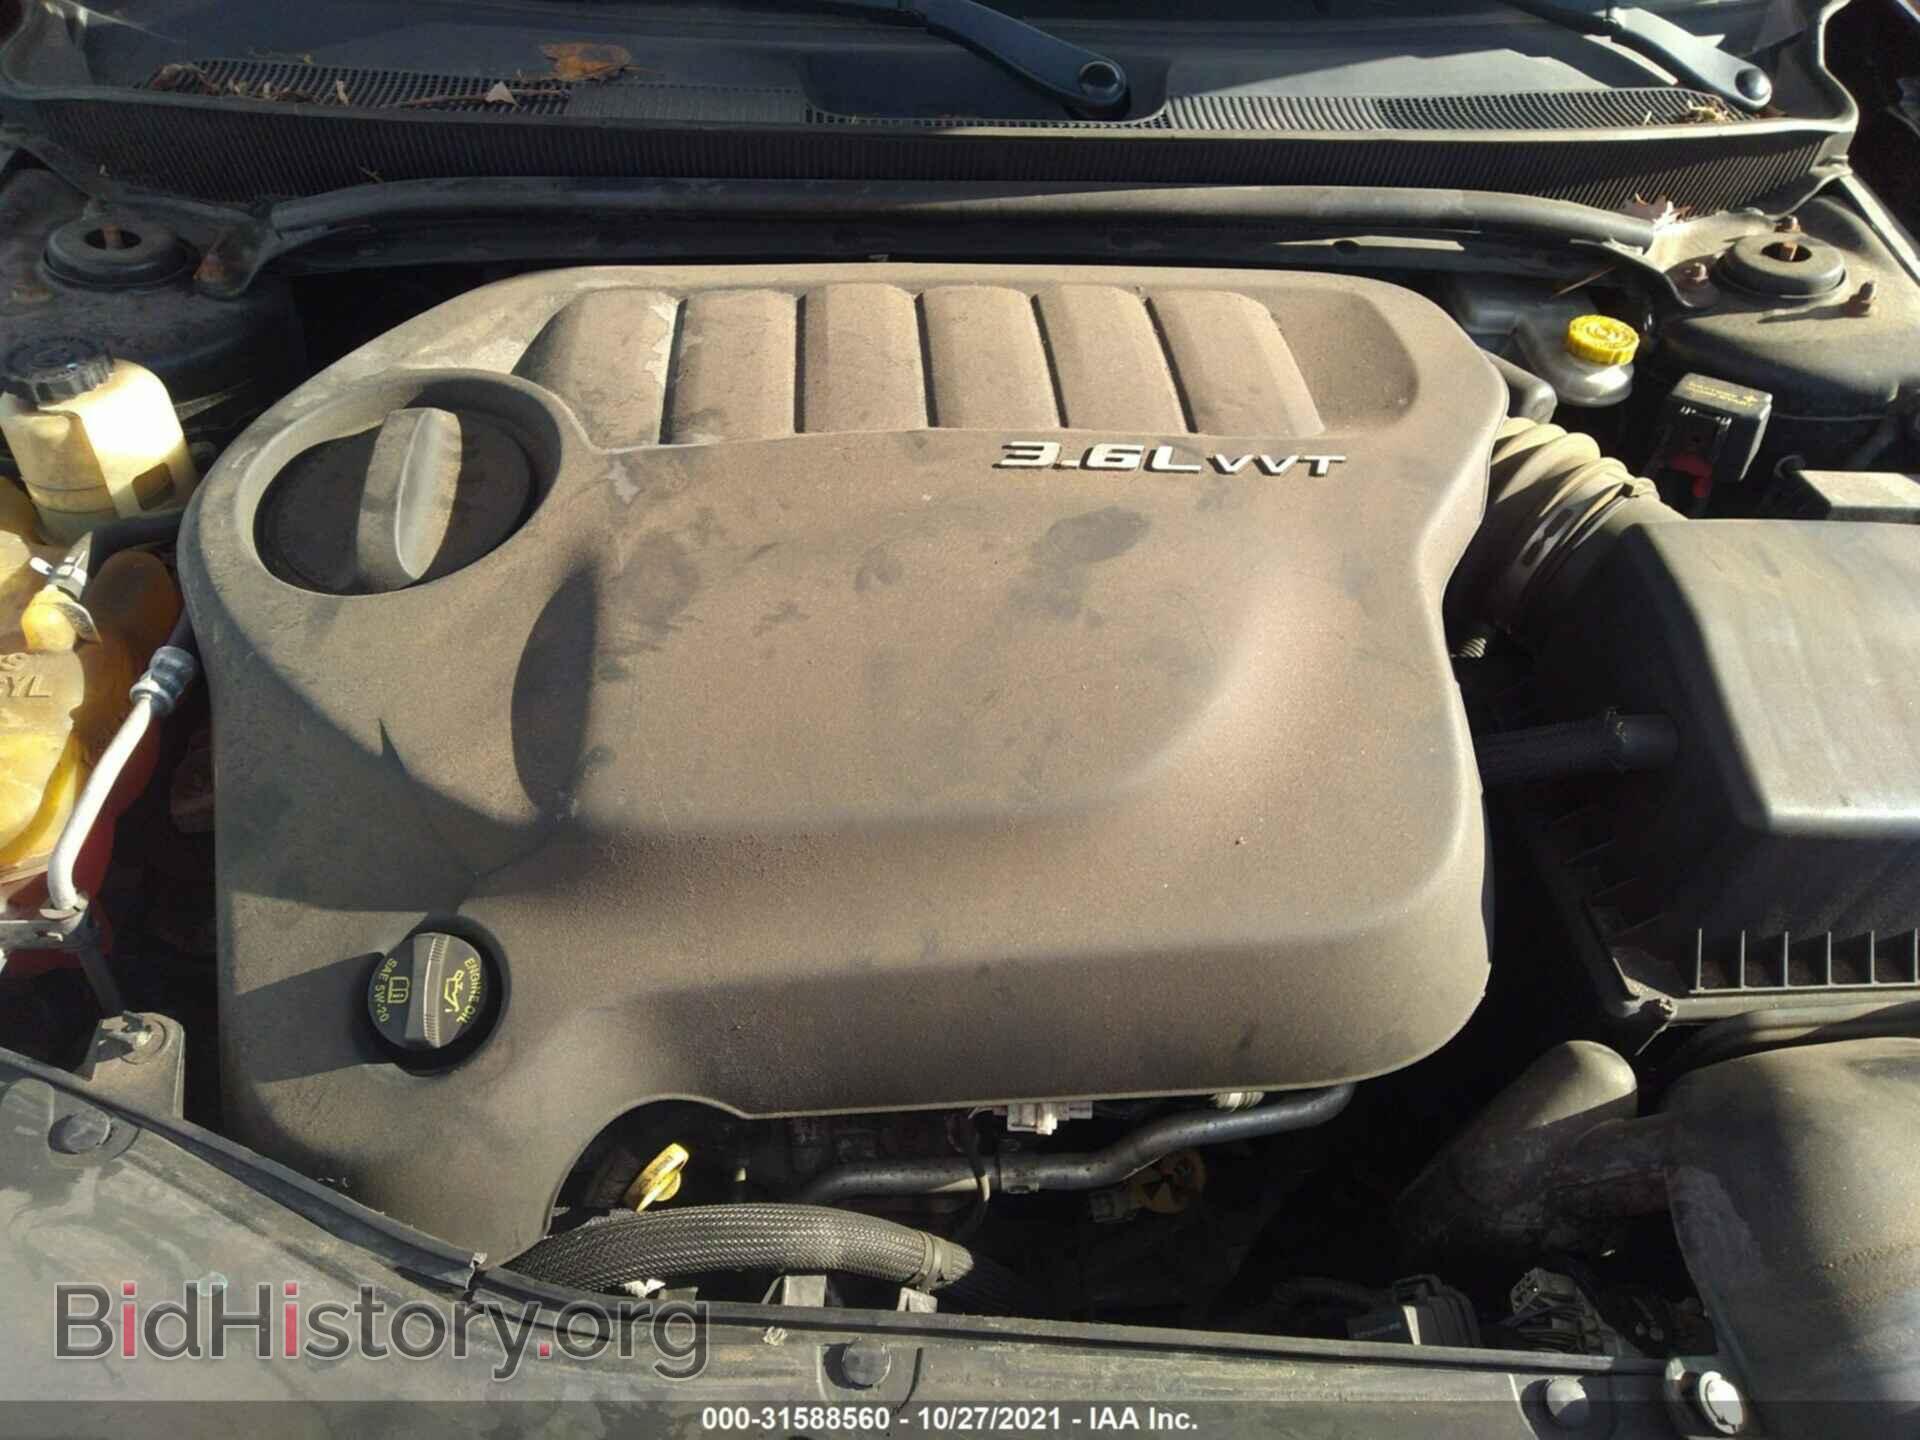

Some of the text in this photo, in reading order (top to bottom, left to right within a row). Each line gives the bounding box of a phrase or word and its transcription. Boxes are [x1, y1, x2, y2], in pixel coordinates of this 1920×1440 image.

[992, 440, 1347, 478] 3.6L VVT
[378, 957, 398, 982] SAE
[456, 957, 481, 1024] ENGINE OIL
